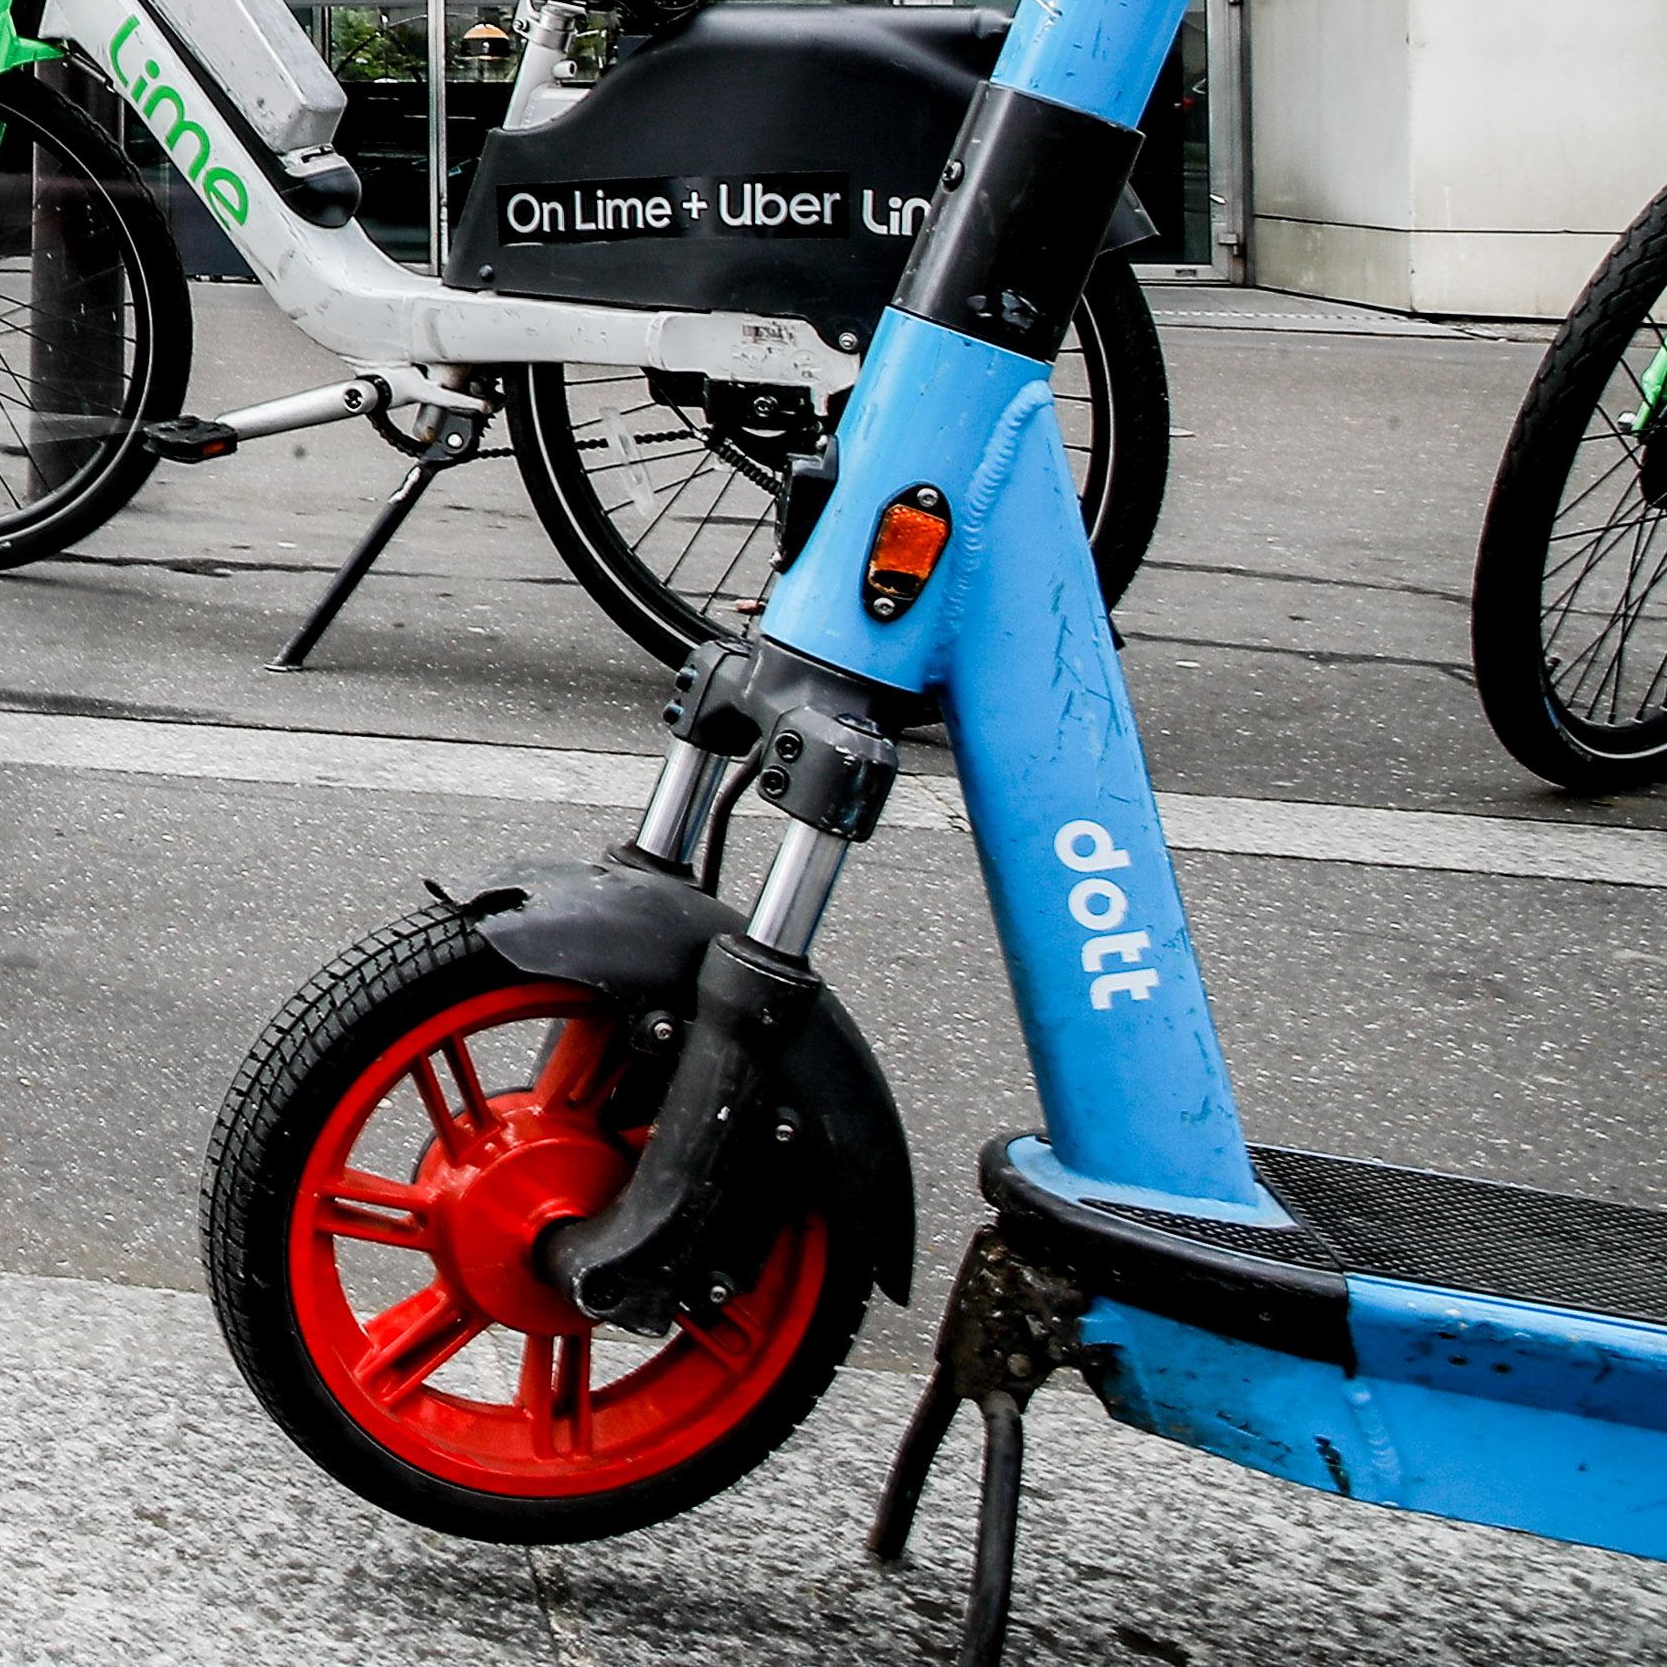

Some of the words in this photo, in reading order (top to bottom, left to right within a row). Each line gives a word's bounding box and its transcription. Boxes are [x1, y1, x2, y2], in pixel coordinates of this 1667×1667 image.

[109, 14, 249, 232] Lime
[507, 193, 565, 233] On
[574, 189, 672, 230] Lime
[719, 183, 842, 226] Uber
[1054, 820, 1159, 1010] dott
